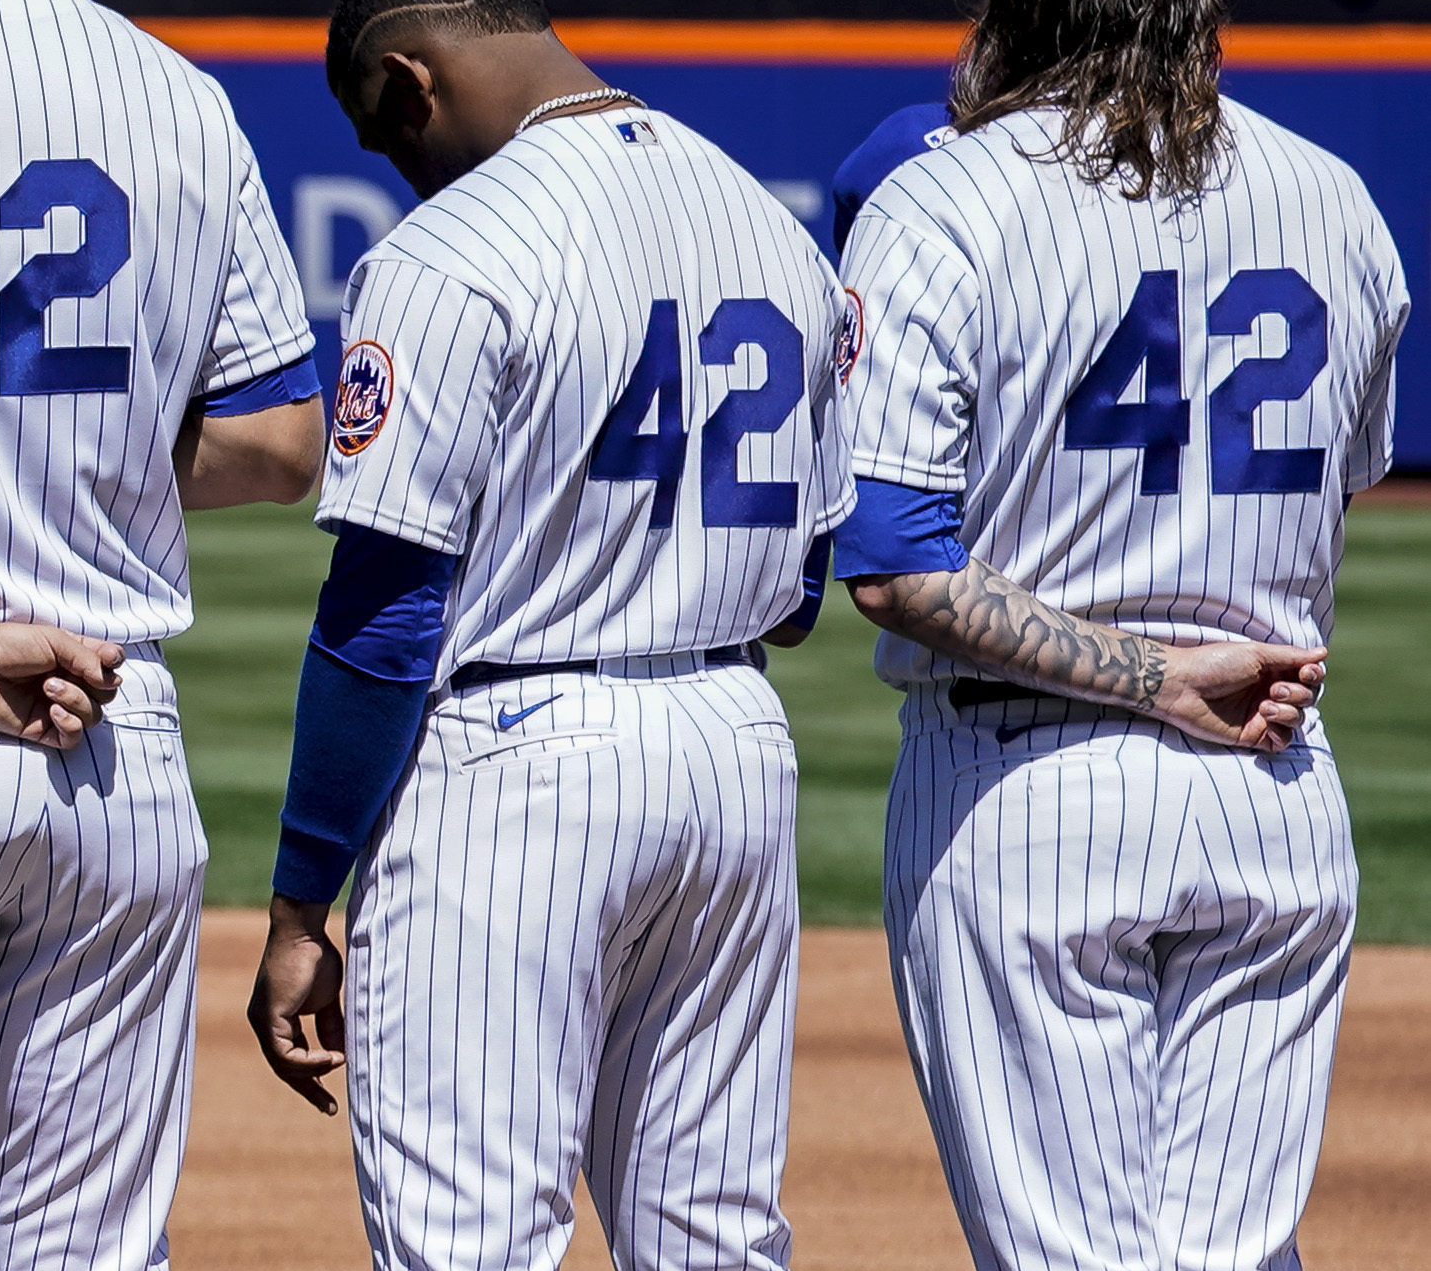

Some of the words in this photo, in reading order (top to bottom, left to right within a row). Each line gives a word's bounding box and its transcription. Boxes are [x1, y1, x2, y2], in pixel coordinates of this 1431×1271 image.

[337, 382, 379, 422] Mets
[588, 297, 805, 530] 42
[1063, 267, 1329, 496] 42
